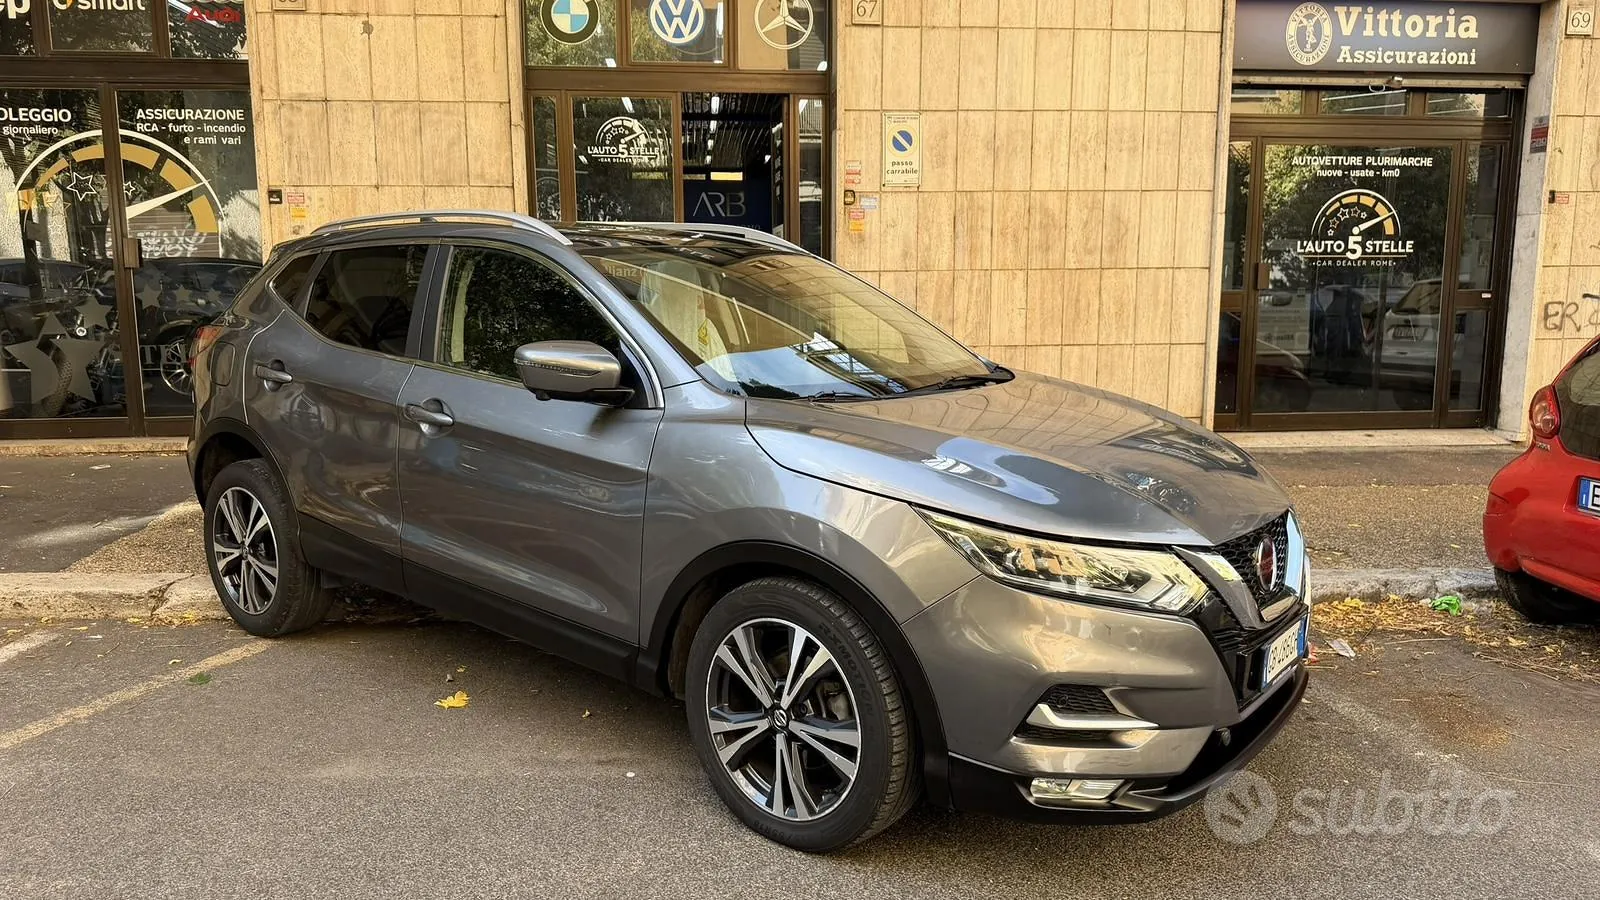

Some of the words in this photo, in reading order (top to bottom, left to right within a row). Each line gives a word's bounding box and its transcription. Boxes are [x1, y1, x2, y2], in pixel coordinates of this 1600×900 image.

[0, 0, 30, 19] p
[77, 0, 146, 10] smart
[857, 0, 877, 18] 67
[1334, 6, 1479, 40] Vittoria
[1571, 11, 1591, 29] 69
[1337, 46, 1477, 66] Assicurazioni
[136, 109, 245, 121] ASSICURAZIONE
[3, 123, 59, 136] giornaliero
[136, 123, 159, 132] RCA
[168, 123, 194, 132] furto
[203, 123, 246, 133] incendio
[194, 136, 217, 145] rami
[222, 136, 241, 145] vari
[587, 146, 617, 154] L'AUTO
[618, 144, 629, 158] 5
[629, 147, 660, 155] STELLE
[1292, 156, 1363, 167] AUTOVETTURE
[1365, 156, 1433, 167] PLURIMARCHE
[1350, 169, 1374, 177] usate
[693, 192, 747, 217] ARB
[1297, 240, 1345, 253] L'AUTO
[1346, 236, 1362, 259] 5
[1365, 240, 1414, 253] STELLE
